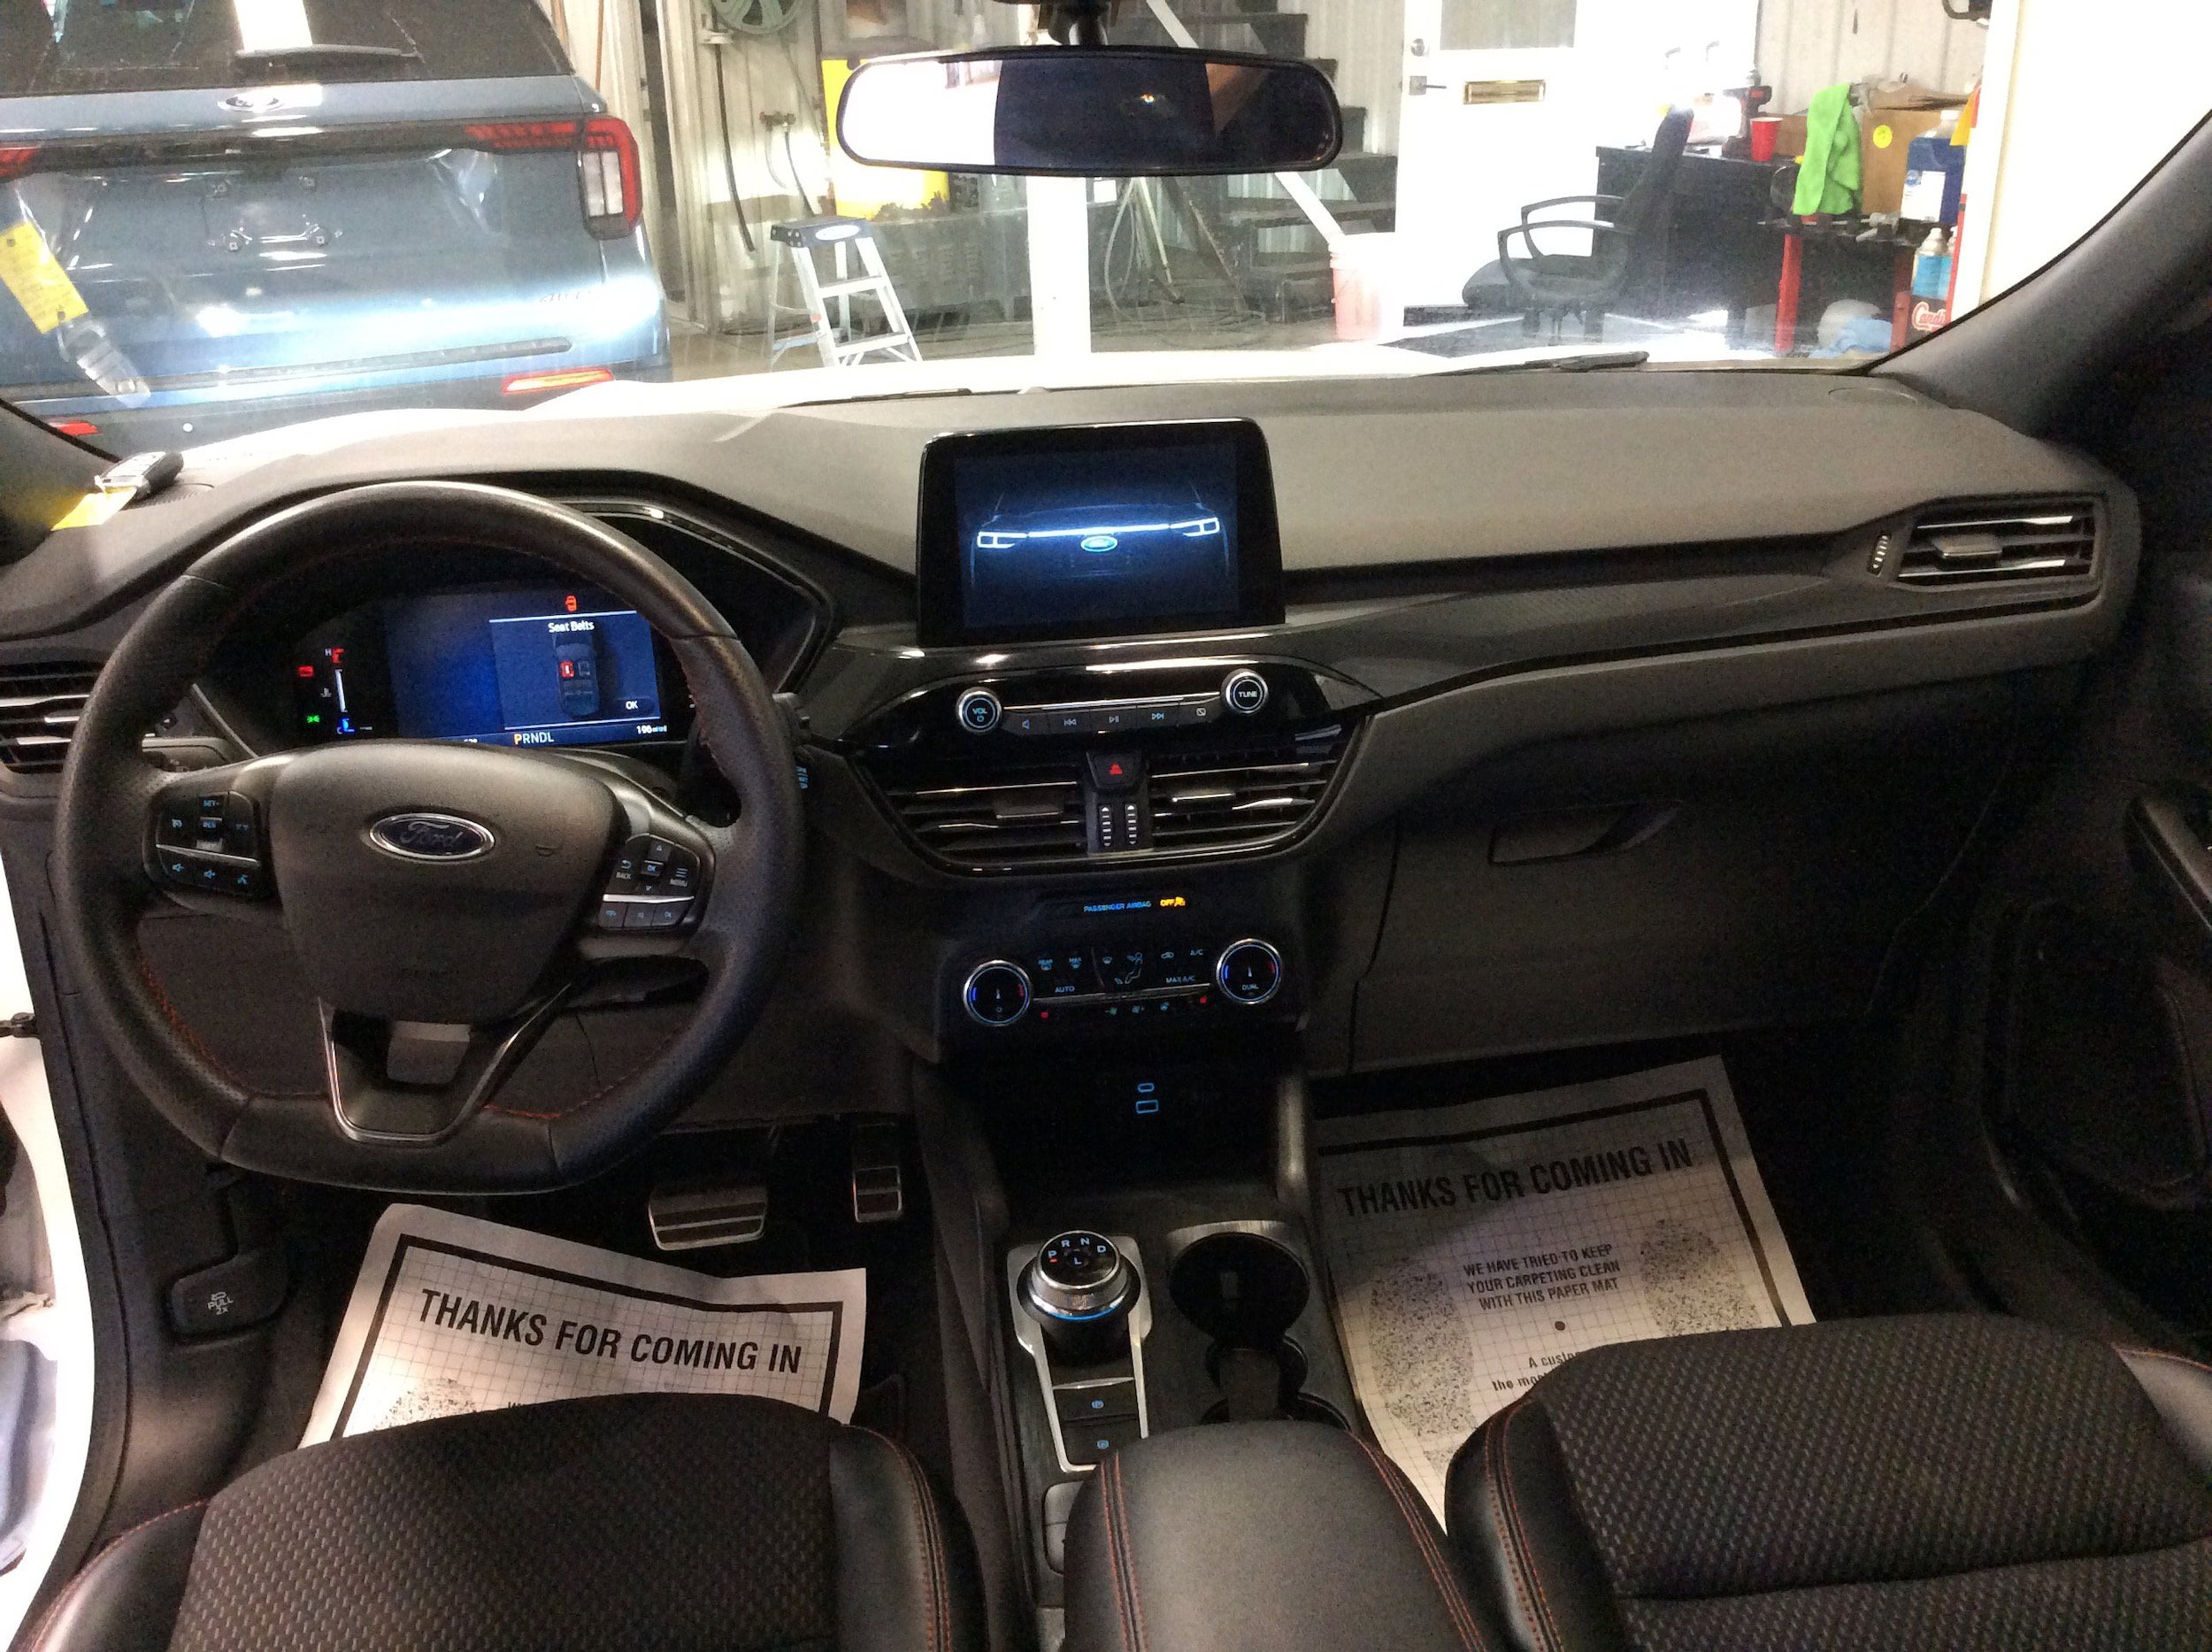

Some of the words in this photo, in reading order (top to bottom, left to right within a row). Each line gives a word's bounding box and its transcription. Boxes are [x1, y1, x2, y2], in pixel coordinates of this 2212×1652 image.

[548, 622, 570, 633] Seat
[571, 620, 595, 631] Belts
[626, 701, 638, 710] OK
[399, 820, 464, 848] Ford
[1083, 903, 1125, 912] PASSENGER
[1125, 900, 1152, 910] AIRBAG
[1054, 985, 1075, 994] AUTO
[1337, 1176, 1456, 1217] THANKS
[1463, 1169, 1525, 1204] FOR
[1529, 1145, 1653, 1195] COMING
[1658, 1137, 1694, 1172] IN
[1080, 1237, 1090, 1246] N
[1096, 1245, 1107, 1254] D
[1463, 1263, 1485, 1277] WE
[1486, 1257, 1519, 1273] HAVE
[1523, 1253, 1558, 1268] TRIED
[1561, 1249, 1578, 1263] TO
[1581, 1243, 1613, 1259] KEEP
[1466, 1278, 1503, 1294] YOUR
[1506, 1267, 1577, 1289] CARPETING
[1579, 1259, 1621, 1278] CLEAN
[1479, 1295, 1514, 1310] WITH
[1517, 1289, 1546, 1305] THIS
[1548, 1283, 1590, 1300] PAPER
[1593, 1277, 1620, 1293] MAT
[207, 1296, 234, 1310] PULL
[419, 1288, 545, 1347] THANKS
[555, 1320, 621, 1359] FOR
[630, 1333, 757, 1371] COMING
[769, 1344, 802, 1374] IN
[1528, 1356, 1538, 1368] A
[1540, 1351, 1581, 1367] custo
[1492, 1379, 1514, 1392] the
